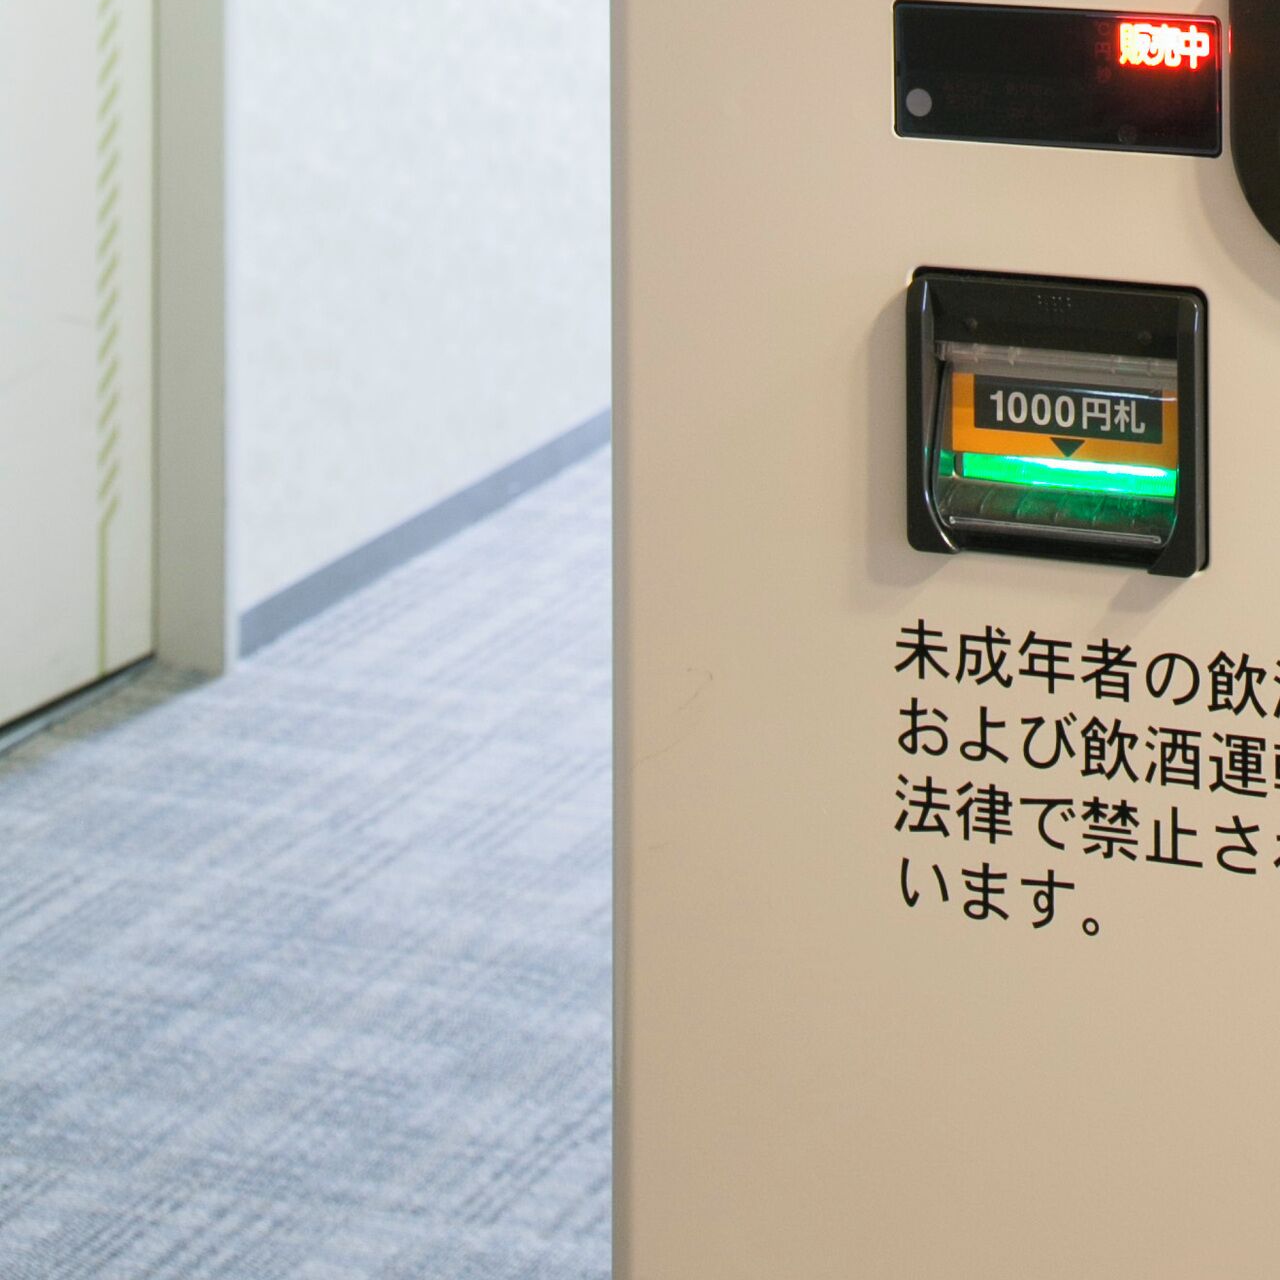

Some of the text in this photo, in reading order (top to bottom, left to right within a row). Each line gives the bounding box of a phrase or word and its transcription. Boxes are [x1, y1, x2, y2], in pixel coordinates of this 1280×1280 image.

[1119, 23, 1211, 70] 販売中
[989, 390, 1147, 435] 1000円札
[900, 857, 1101, 938] います。
